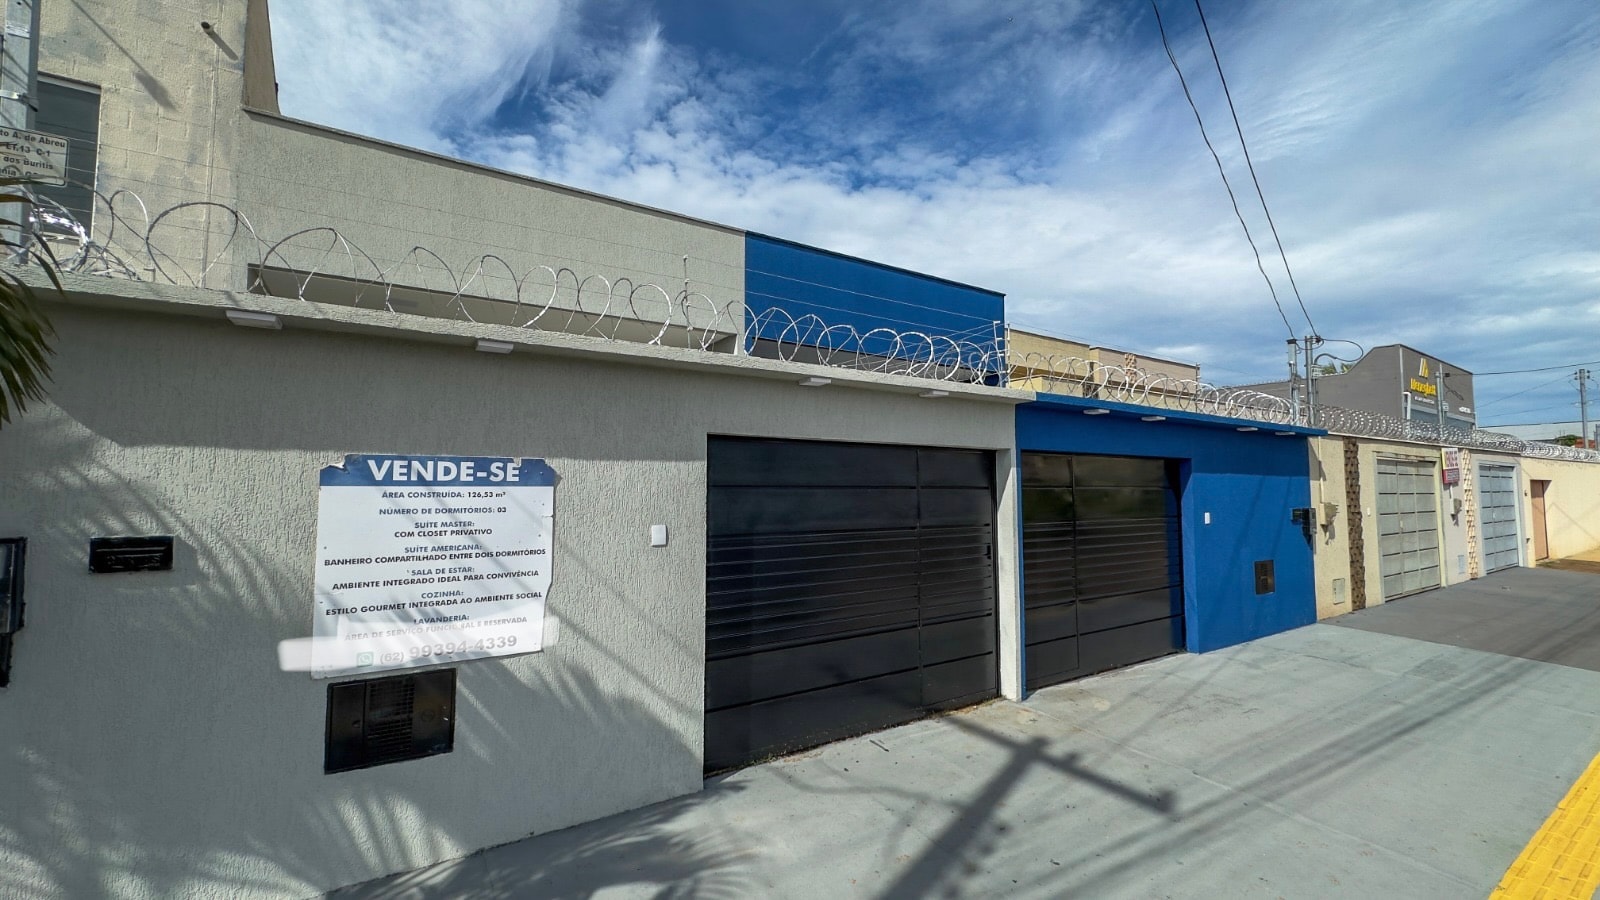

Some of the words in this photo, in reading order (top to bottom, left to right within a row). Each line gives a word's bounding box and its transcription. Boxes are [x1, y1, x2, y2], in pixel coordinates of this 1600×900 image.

[12, 131, 21, 139] A.
[39, 137, 65, 148] Abreu
[4, 156, 20, 164] dos
[24, 159, 53, 169] Buritis
[367, 460, 520, 482] VENDE-SE
[382, 490, 405, 498] ÁREA
[379, 507, 418, 515] NÚMERO
[431, 544, 482, 552] AMERICANA:
[324, 558, 372, 566] BANHEIRO
[375, 554, 446, 564] COMPARTILHADO
[495, 549, 546, 558] DORMITÓRIOS
[332, 581, 380, 590] AMBIENTE
[383, 577, 435, 587] INTEGRADO
[486, 570, 539, 580] CONVIVÊNCIA
[421, 591, 464, 599] COZINHA:
[326, 607, 358, 615] ESTILO
[360, 603, 406, 612] GOURMET
[408, 600, 458, 608] INTEGRADA
[474, 594, 514, 603] AMBIENTE
[386, 627, 424, 637] SERVIÇO
[484, 617, 527, 626] RESERVADA
[414, 614, 470, 624] LAVANDERIA:
[380, 652, 404, 664] (62)
[409, 635, 517, 658] 99394-4339
